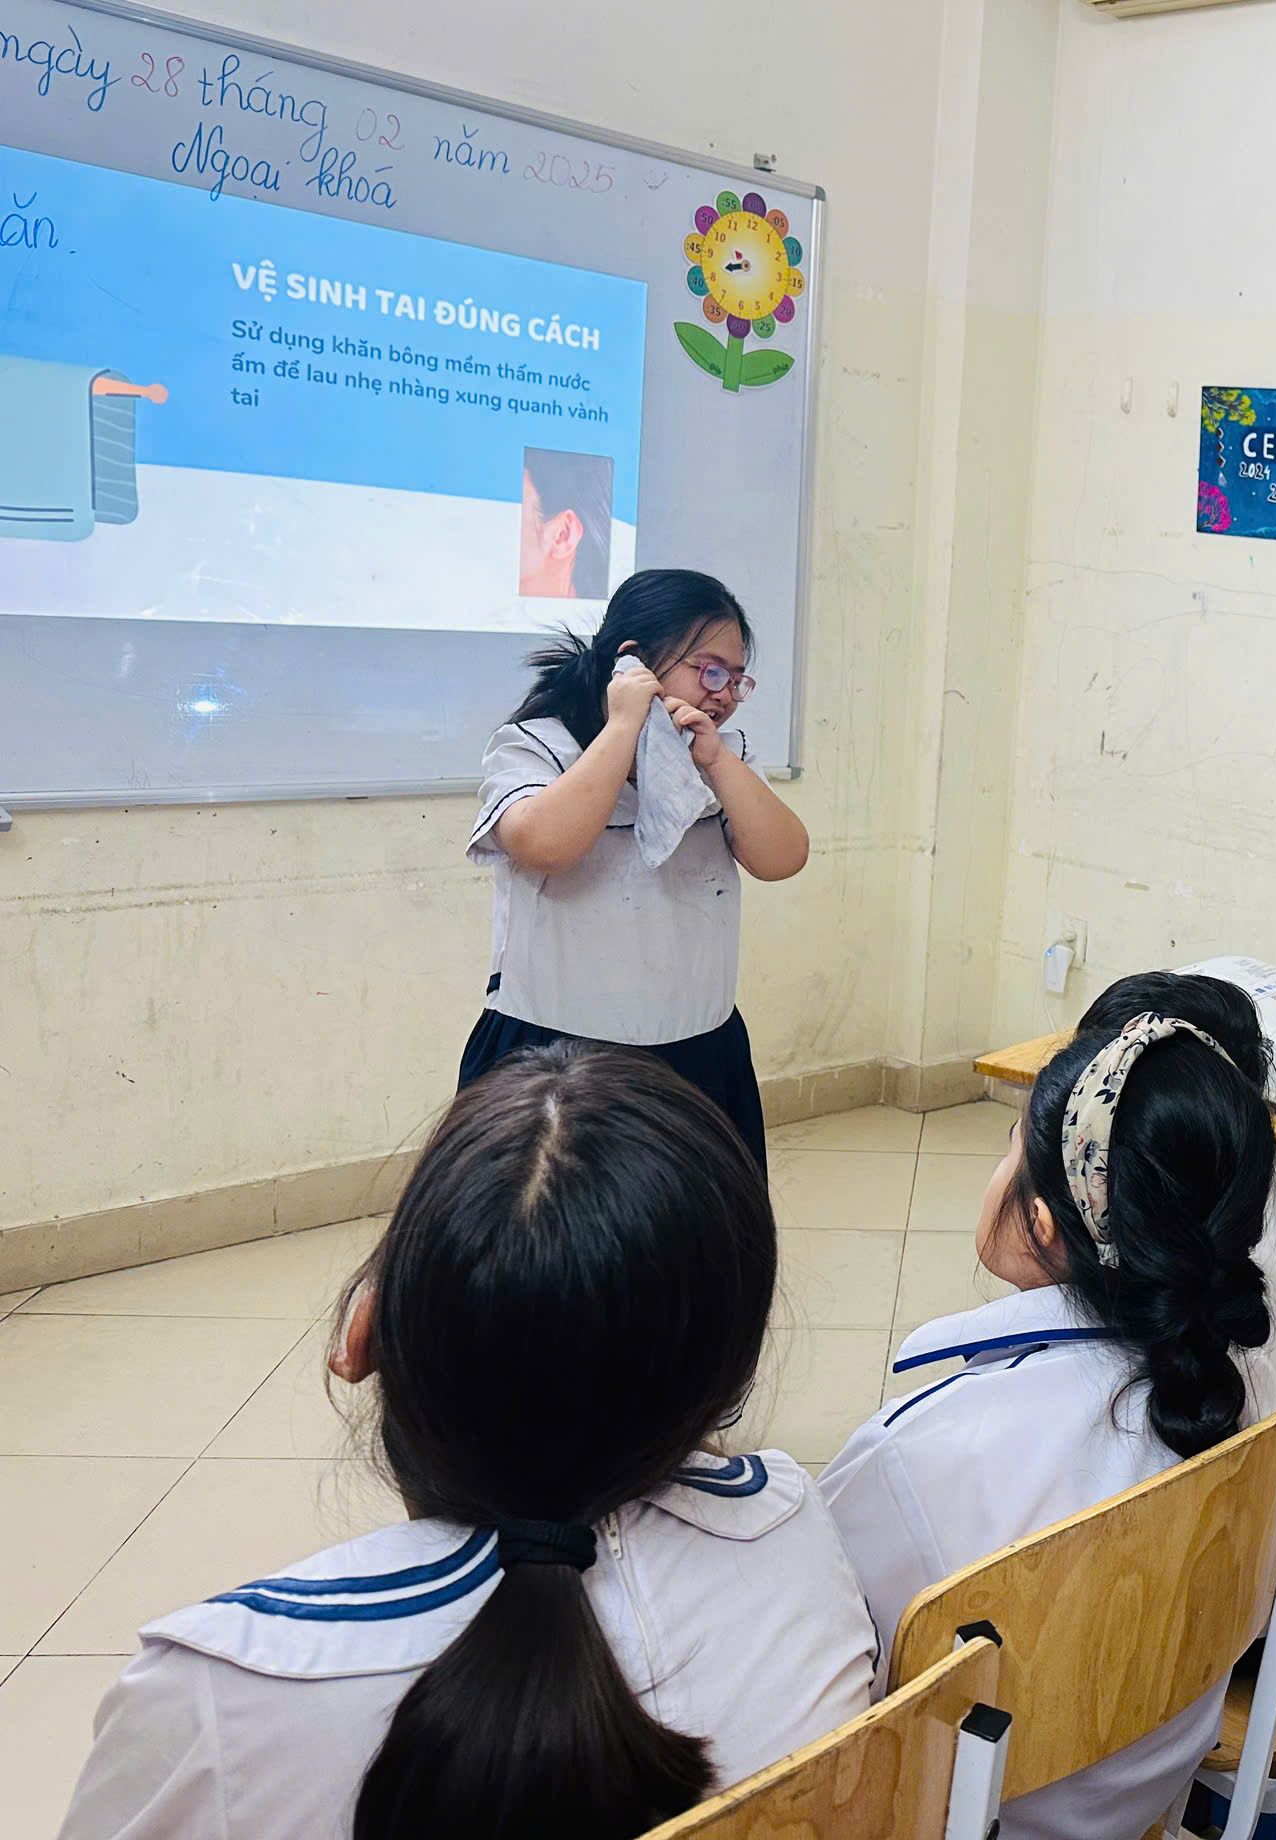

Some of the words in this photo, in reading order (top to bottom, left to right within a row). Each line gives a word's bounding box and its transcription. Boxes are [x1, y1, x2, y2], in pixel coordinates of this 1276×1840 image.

[0, 25, 122, 112] ngày
[131, 52, 185, 97] 28
[198, 54, 328, 163] tháng
[356, 107, 406, 151] 02
[433, 123, 510, 174] năm
[523, 151, 616, 194] 2025
[172, 122, 291, 202] Ngoại
[305, 147, 398, 209] khoá
[728, 219, 738, 232] 11
[747, 219, 758, 232] 12
[715, 231, 726, 243] 10
[707, 248, 714, 258] 9
[709, 272, 716, 282] 8
[776, 272, 782, 282] 3
[232, 259, 278, 303] VỆ
[286, 272, 367, 311] SINH
[375, 289, 425, 322] TAI
[434, 297, 522, 337] ĐÚNG
[528, 313, 601, 351] CÁCH
[738, 300, 744, 310] 6
[754, 300, 761, 310] 5
[231, 319, 263, 340] Sử
[269, 326, 325, 355] dụng
[332, 335, 382, 361] khăn
[389, 345, 439, 372] bông
[445, 353, 491, 377] mềm
[497, 361, 543, 385] thấm
[548, 371, 591, 393] nước
[231, 352, 266, 376] ấm
[273, 355, 301, 380] để
[307, 364, 338, 386] lau
[345, 371, 383, 395] nhẹ
[389, 377, 450, 404] nhàng
[455, 389, 502, 411] xung
[507, 396, 563, 418] quanh
[568, 402, 609, 424] vành
[231, 387, 259, 408] tai
[1239, 461, 1271, 480] 2024
